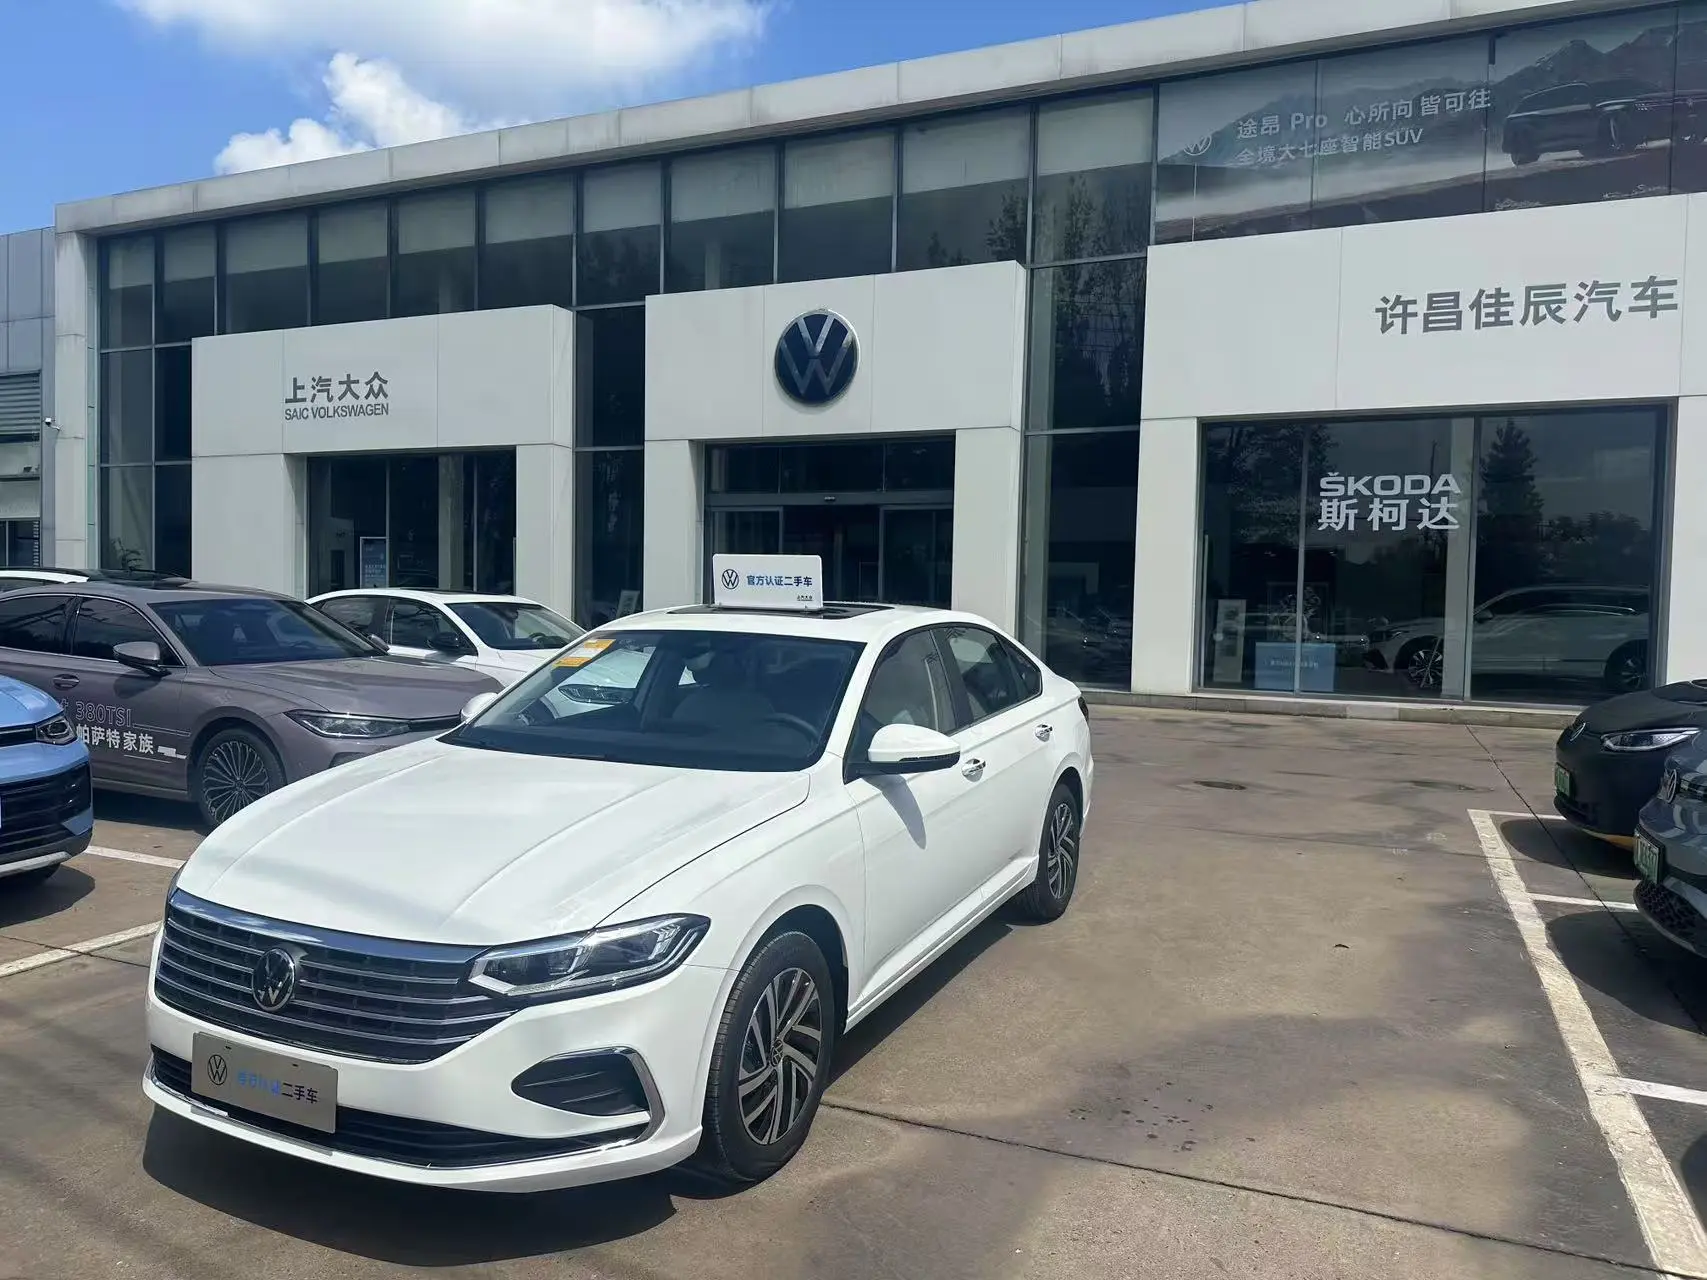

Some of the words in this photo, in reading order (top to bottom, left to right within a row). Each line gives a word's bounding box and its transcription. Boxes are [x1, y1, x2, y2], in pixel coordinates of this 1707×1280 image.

[1237, 114, 1280, 140] 途昂
[1290, 112, 1328, 131] Pro
[1344, 99, 1413, 126] 心所向
[1420, 88, 1492, 117] 皆可往
[1375, 275, 1678, 335] 许昌佳辰汽车
[285, 371, 388, 404] 上汽大众
[285, 407, 309, 420] SAIC
[311, 403, 389, 419] VOLKSWAGEN
[1319, 472, 1461, 496] ŠKODA
[1317, 497, 1460, 531] 斯柯达
[746, 575, 813, 588] 官方认证二手车
[75, 701, 131, 728] 380TSI
[76, 723, 154, 755] 帕萨特家族
